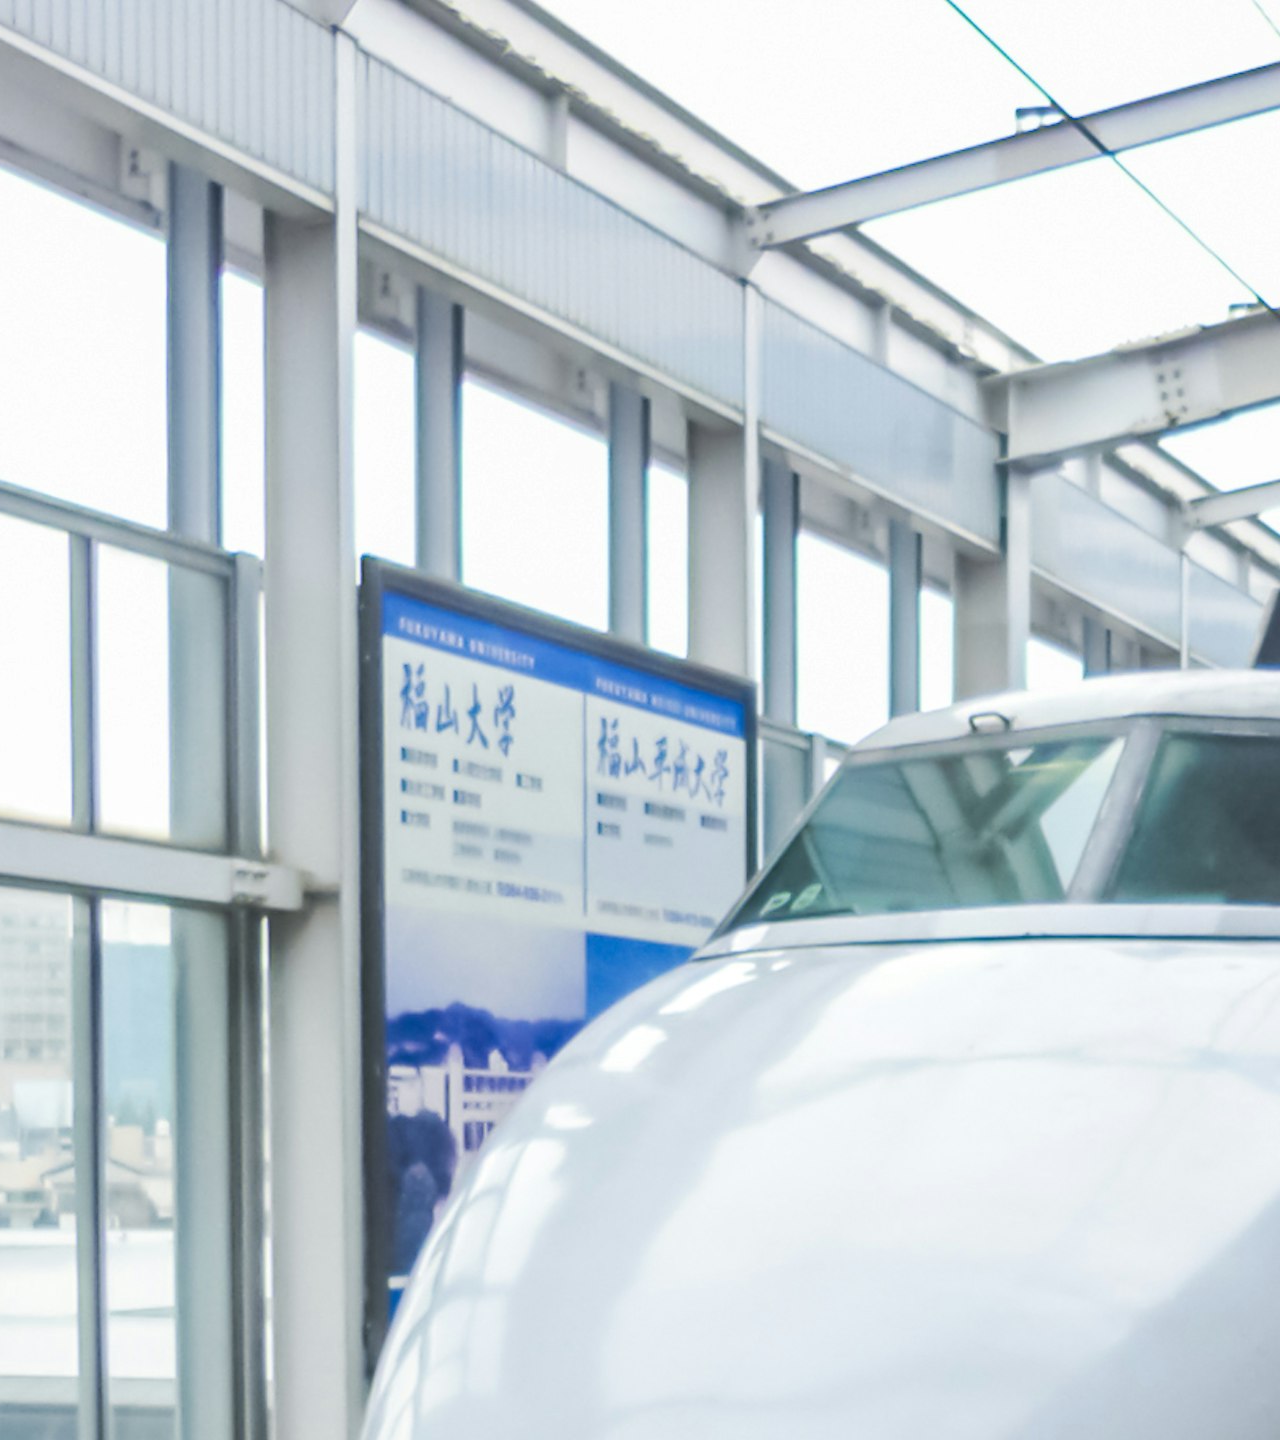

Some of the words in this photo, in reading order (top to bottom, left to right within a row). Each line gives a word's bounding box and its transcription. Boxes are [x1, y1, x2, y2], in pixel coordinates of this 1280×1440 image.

[399, 616, 465, 649] FUKUYAMA
[470, 638, 536, 670] UNIVERSITY
[400, 663, 517, 758] 福山大学
